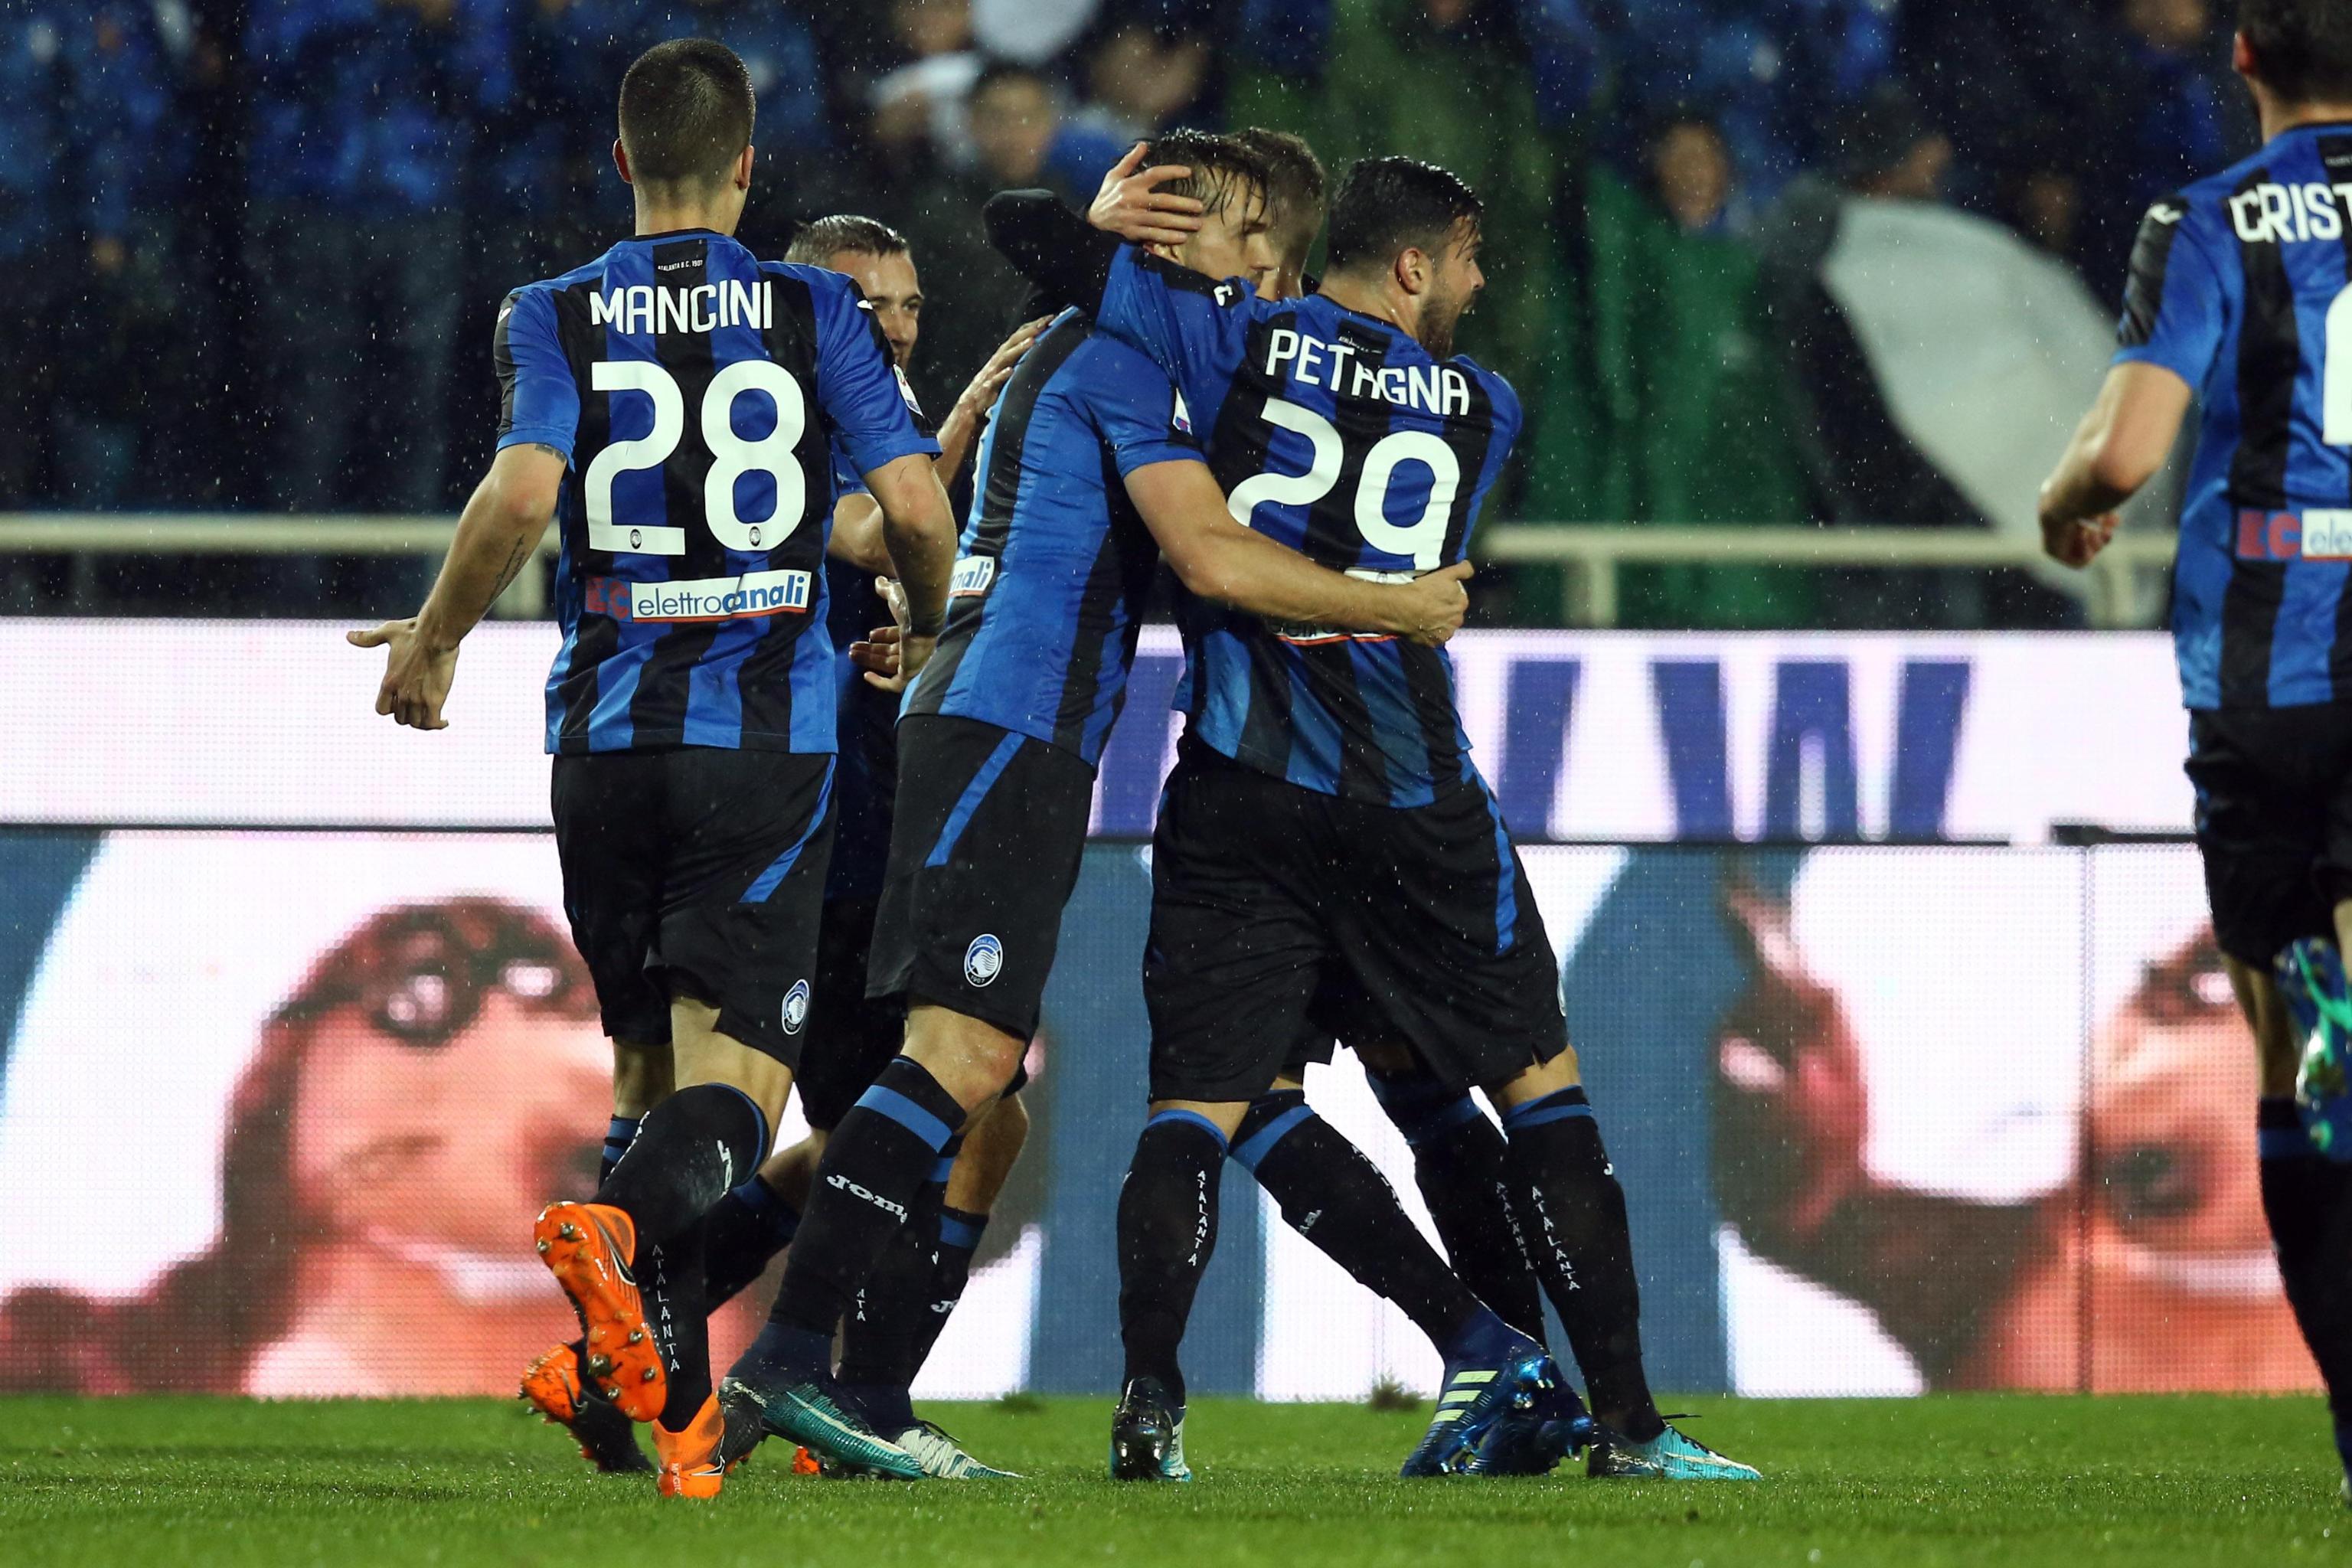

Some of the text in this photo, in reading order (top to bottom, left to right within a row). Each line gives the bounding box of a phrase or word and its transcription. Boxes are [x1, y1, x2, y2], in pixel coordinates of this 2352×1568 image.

[590, 279, 773, 335] MANCINI
[1265, 328, 1471, 416] PETAGNA
[585, 360, 806, 555] 28
[1227, 397, 1461, 584] 29
[586, 574, 805, 620] EC elettrocanali
[1187, 1170, 1208, 1266] ATALANTA
[1496, 1181, 1534, 1270] ATALANTA
[1532, 1186, 1580, 1290] ATALANTA
[652, 1244, 680, 1372] ATALANTA
